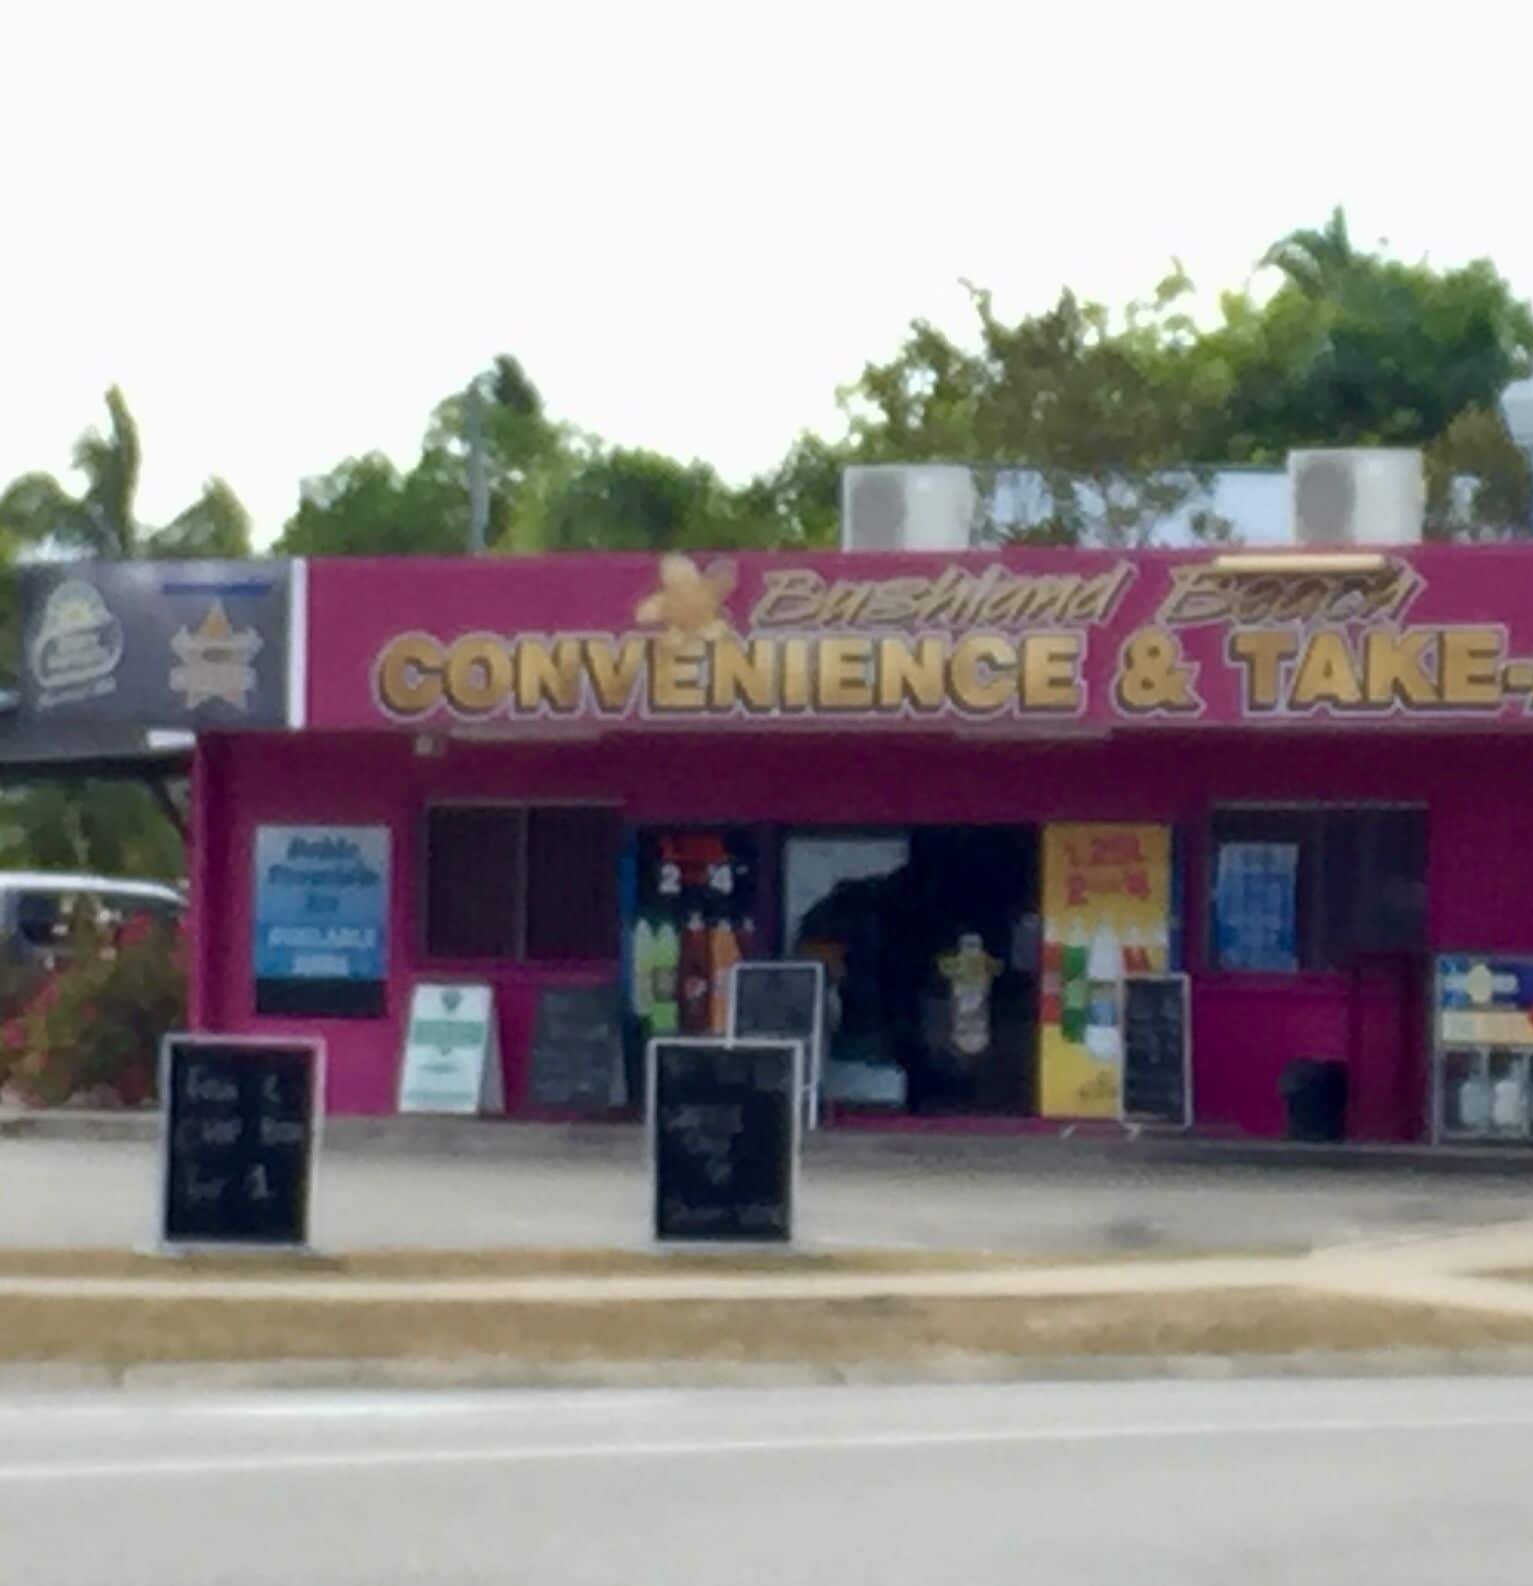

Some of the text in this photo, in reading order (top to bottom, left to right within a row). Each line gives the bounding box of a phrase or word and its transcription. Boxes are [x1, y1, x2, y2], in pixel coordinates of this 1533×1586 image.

[752, 563, 1135, 627] Bushland
[377, 633, 1083, 716] CONVENIENCE
[1117, 626, 1200, 714] &
